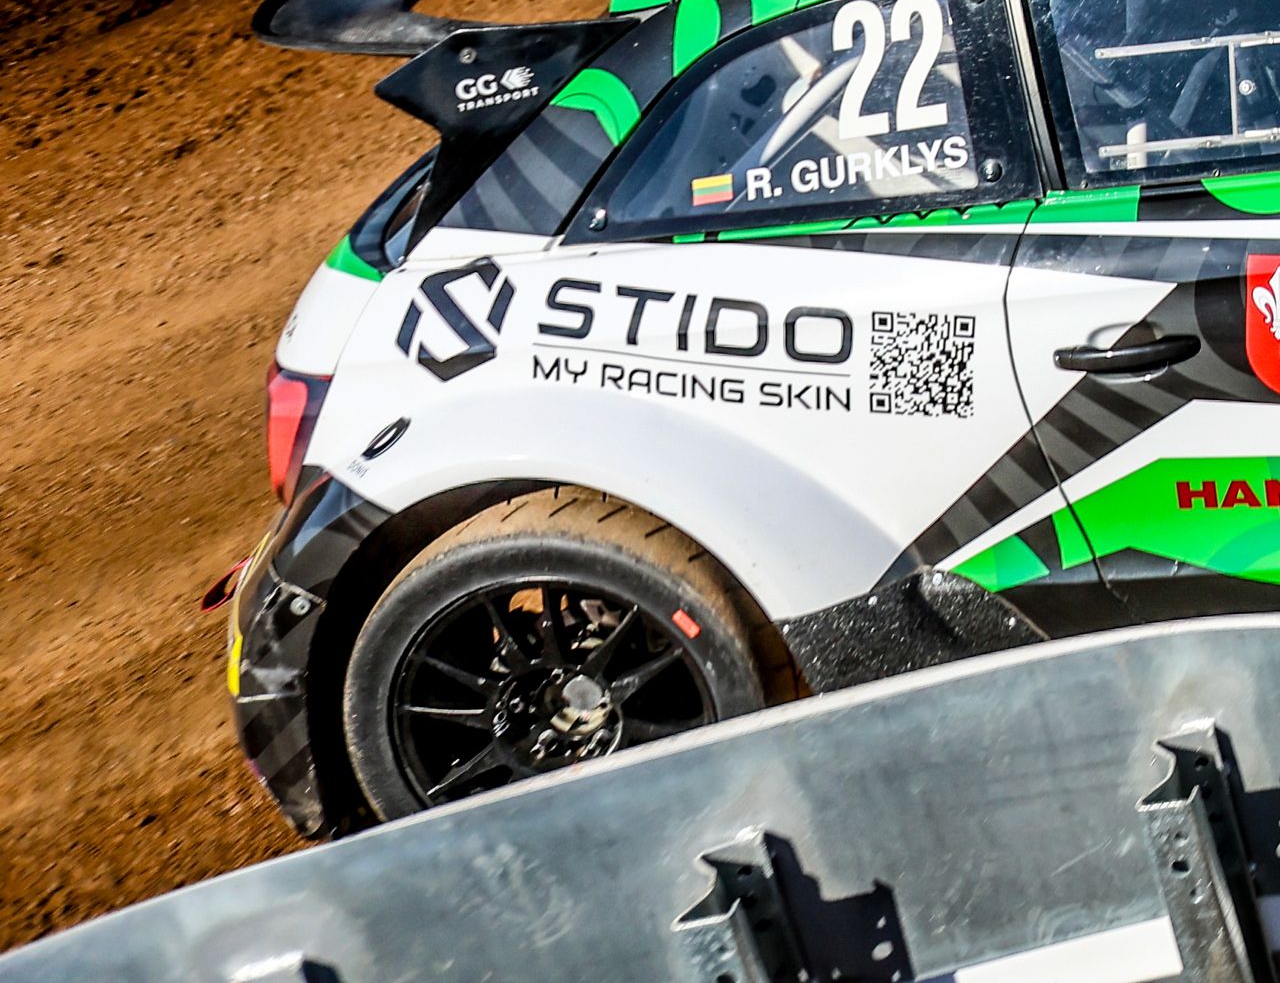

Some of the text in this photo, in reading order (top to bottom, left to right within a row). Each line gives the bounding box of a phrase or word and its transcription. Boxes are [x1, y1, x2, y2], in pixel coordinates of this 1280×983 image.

[455, 73, 499, 101] GG
[457, 86, 540, 113] TRANSPORT
[745, 136, 969, 202] R. GURKLYS
[537, 276, 854, 365] STIDO
[531, 355, 853, 413] MY RACING SKIN
